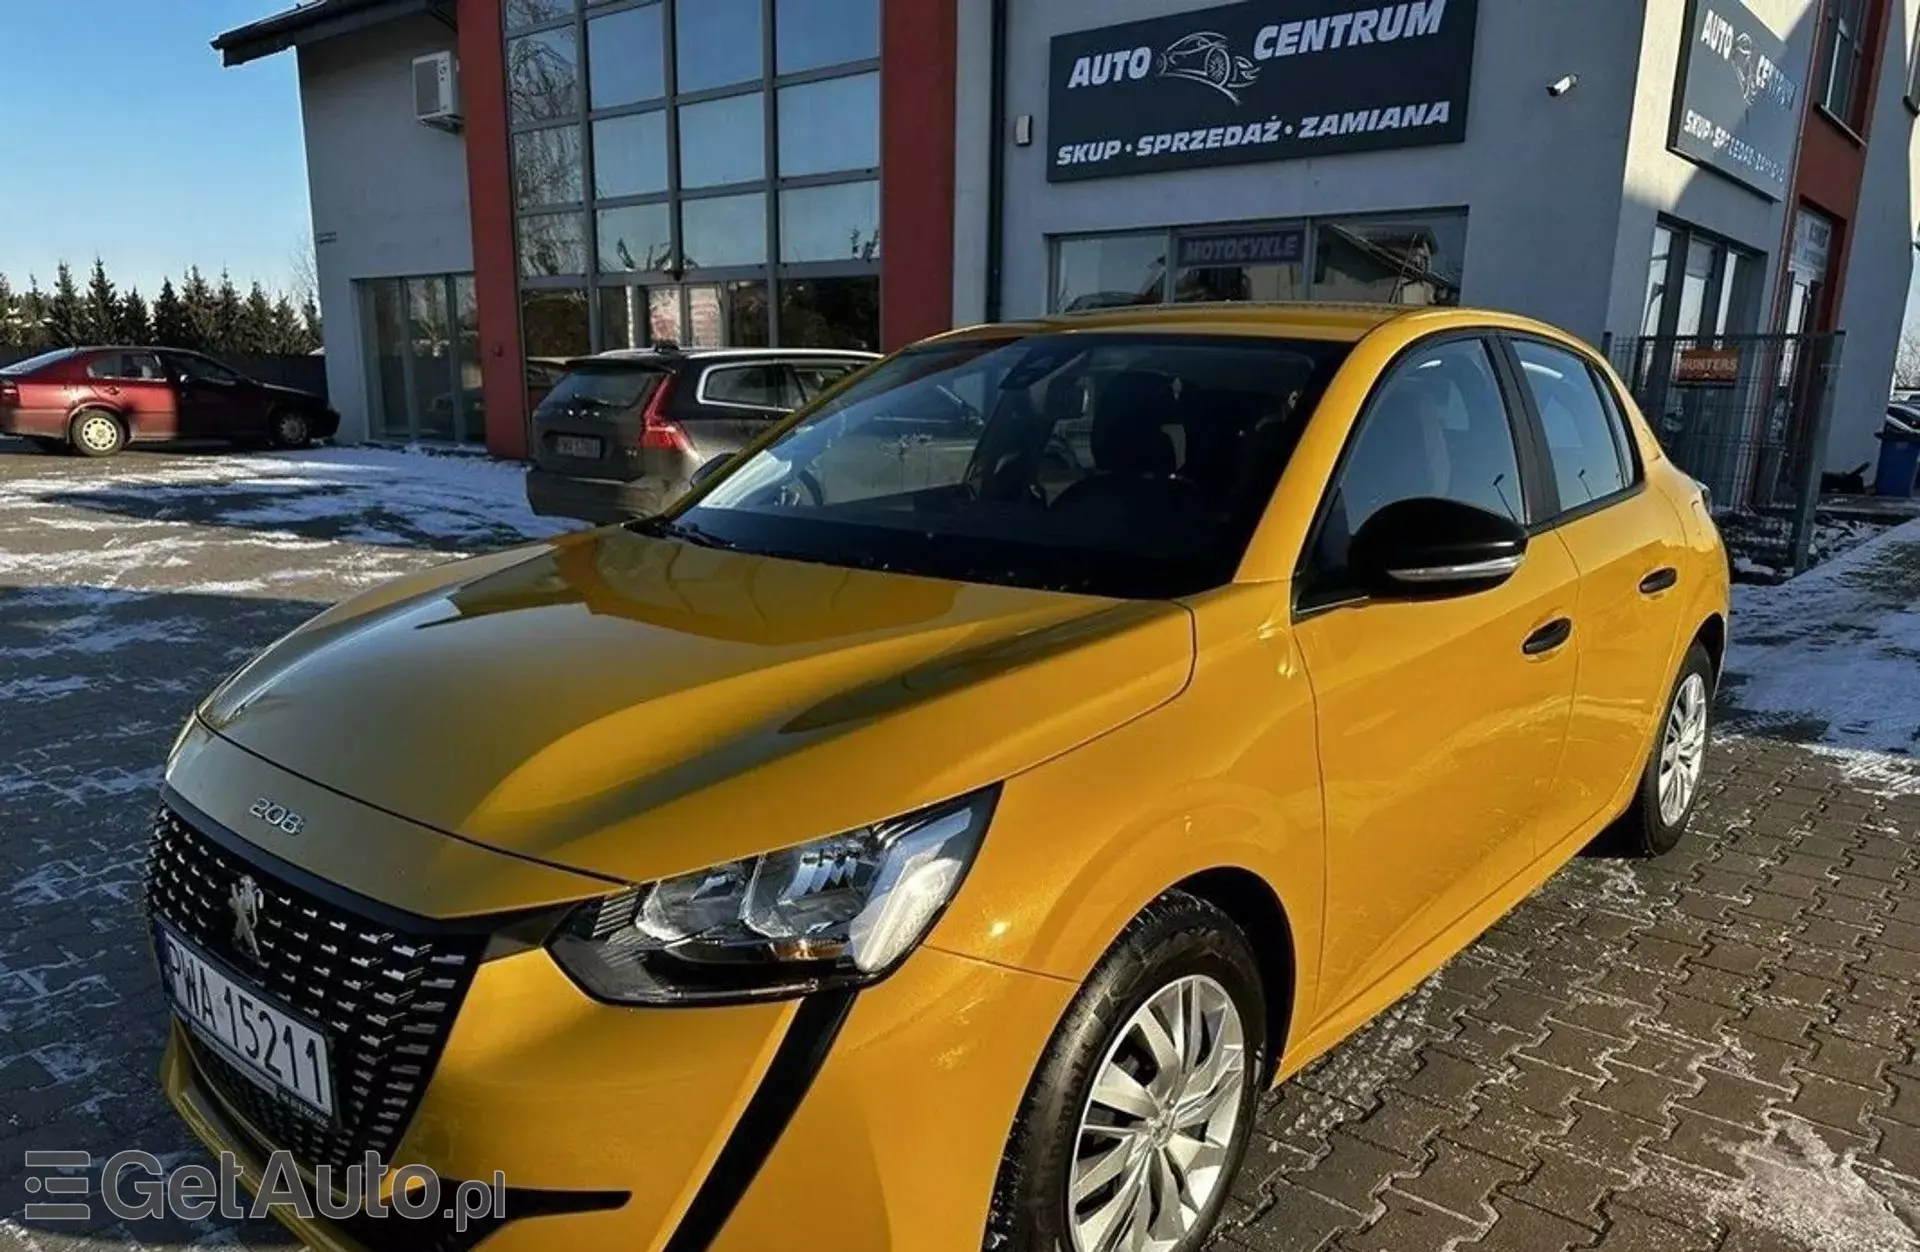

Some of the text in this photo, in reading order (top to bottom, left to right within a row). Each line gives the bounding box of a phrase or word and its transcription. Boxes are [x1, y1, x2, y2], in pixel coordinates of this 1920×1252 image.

[1067, 0, 1447, 88] AUTO CENTRUM
[1701, 8, 1734, 60] AUTO
[1056, 101, 1450, 165] SKUP SPRZEDAŻ ZAMIANA
[1184, 235, 1298, 261] MOTOCYKLE
[249, 797, 303, 834] 208
[223, 985, 324, 1105] 15211
